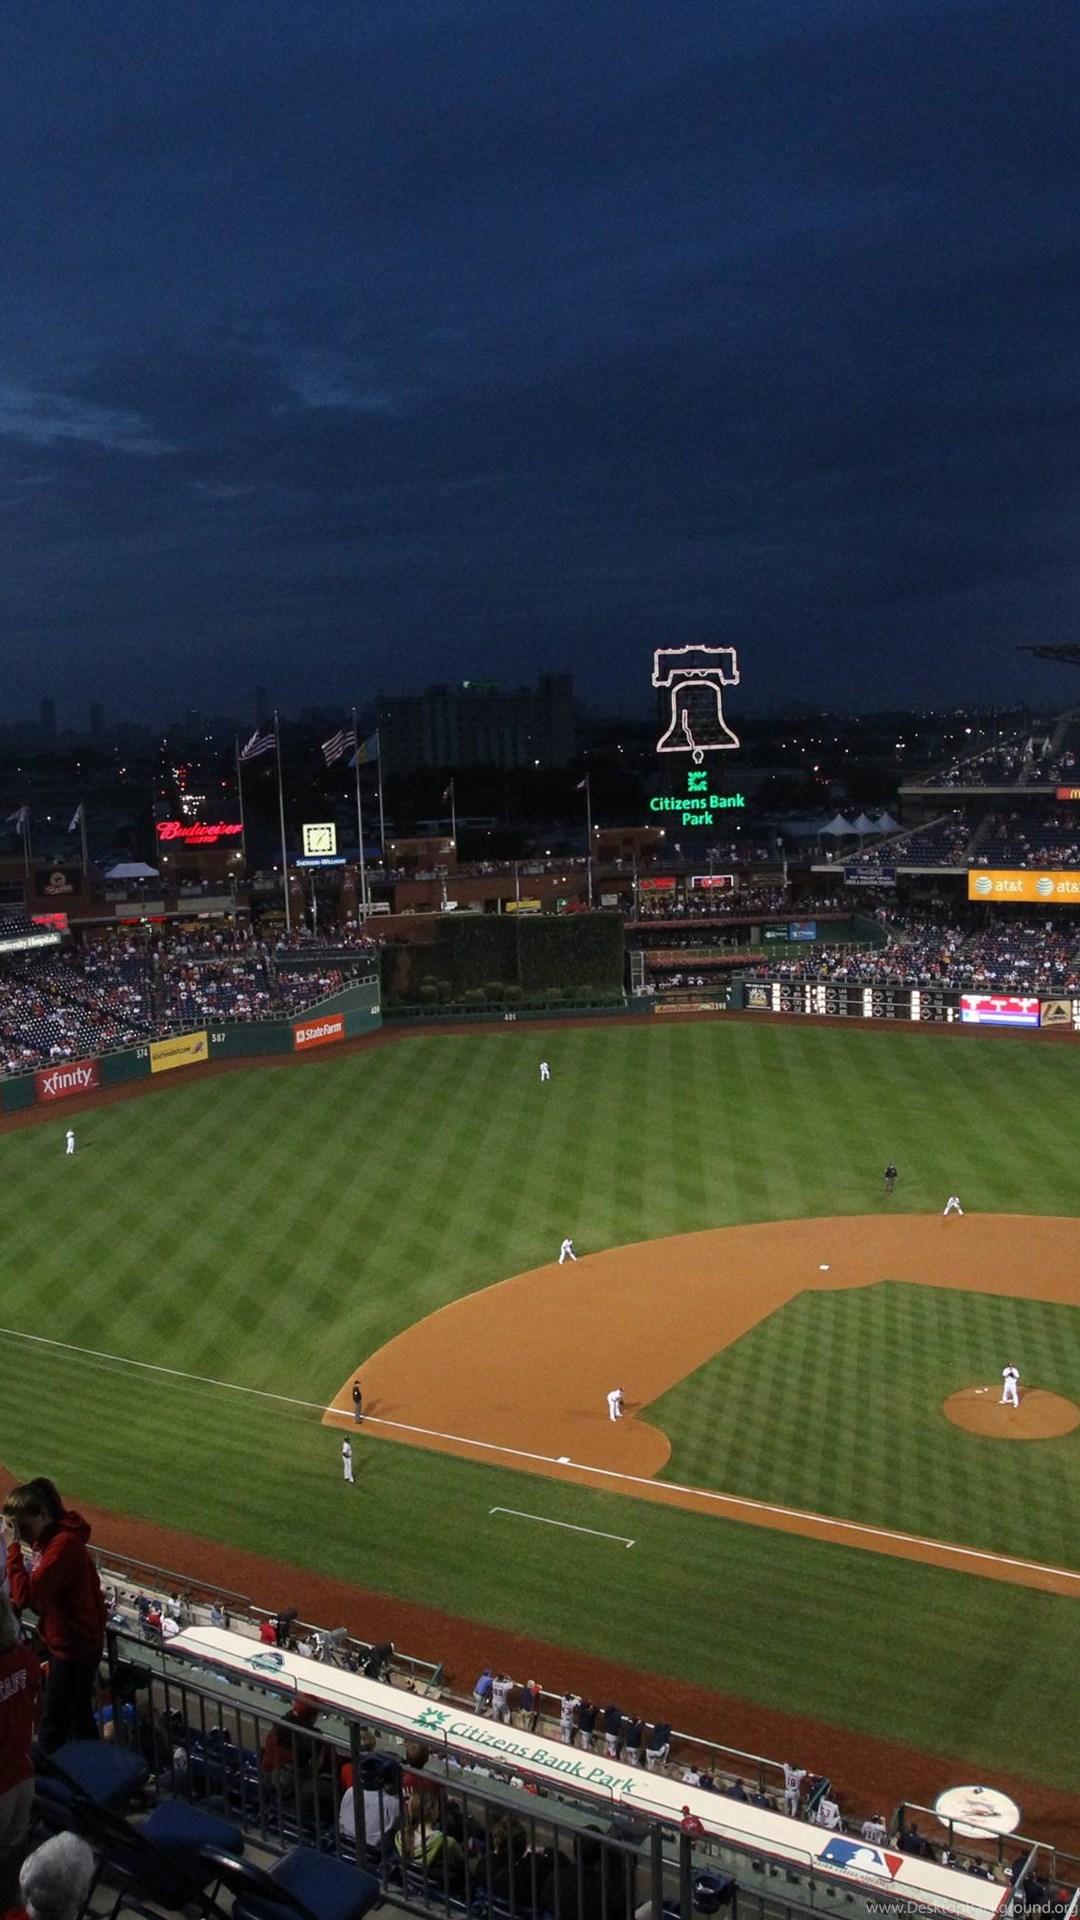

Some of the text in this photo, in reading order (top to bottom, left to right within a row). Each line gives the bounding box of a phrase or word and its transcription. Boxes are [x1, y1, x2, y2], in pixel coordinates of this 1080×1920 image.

[650, 793, 745, 811] Citizens Bank
[682, 811, 713, 826] Park
[156, 822, 243, 840] Budweiser
[995, 880, 1024, 893] at&t
[1056, 881, 1080, 893] at&
[43, 1067, 92, 1095] xfinity
[450, 1721, 637, 1793] Citizens Bank Park
